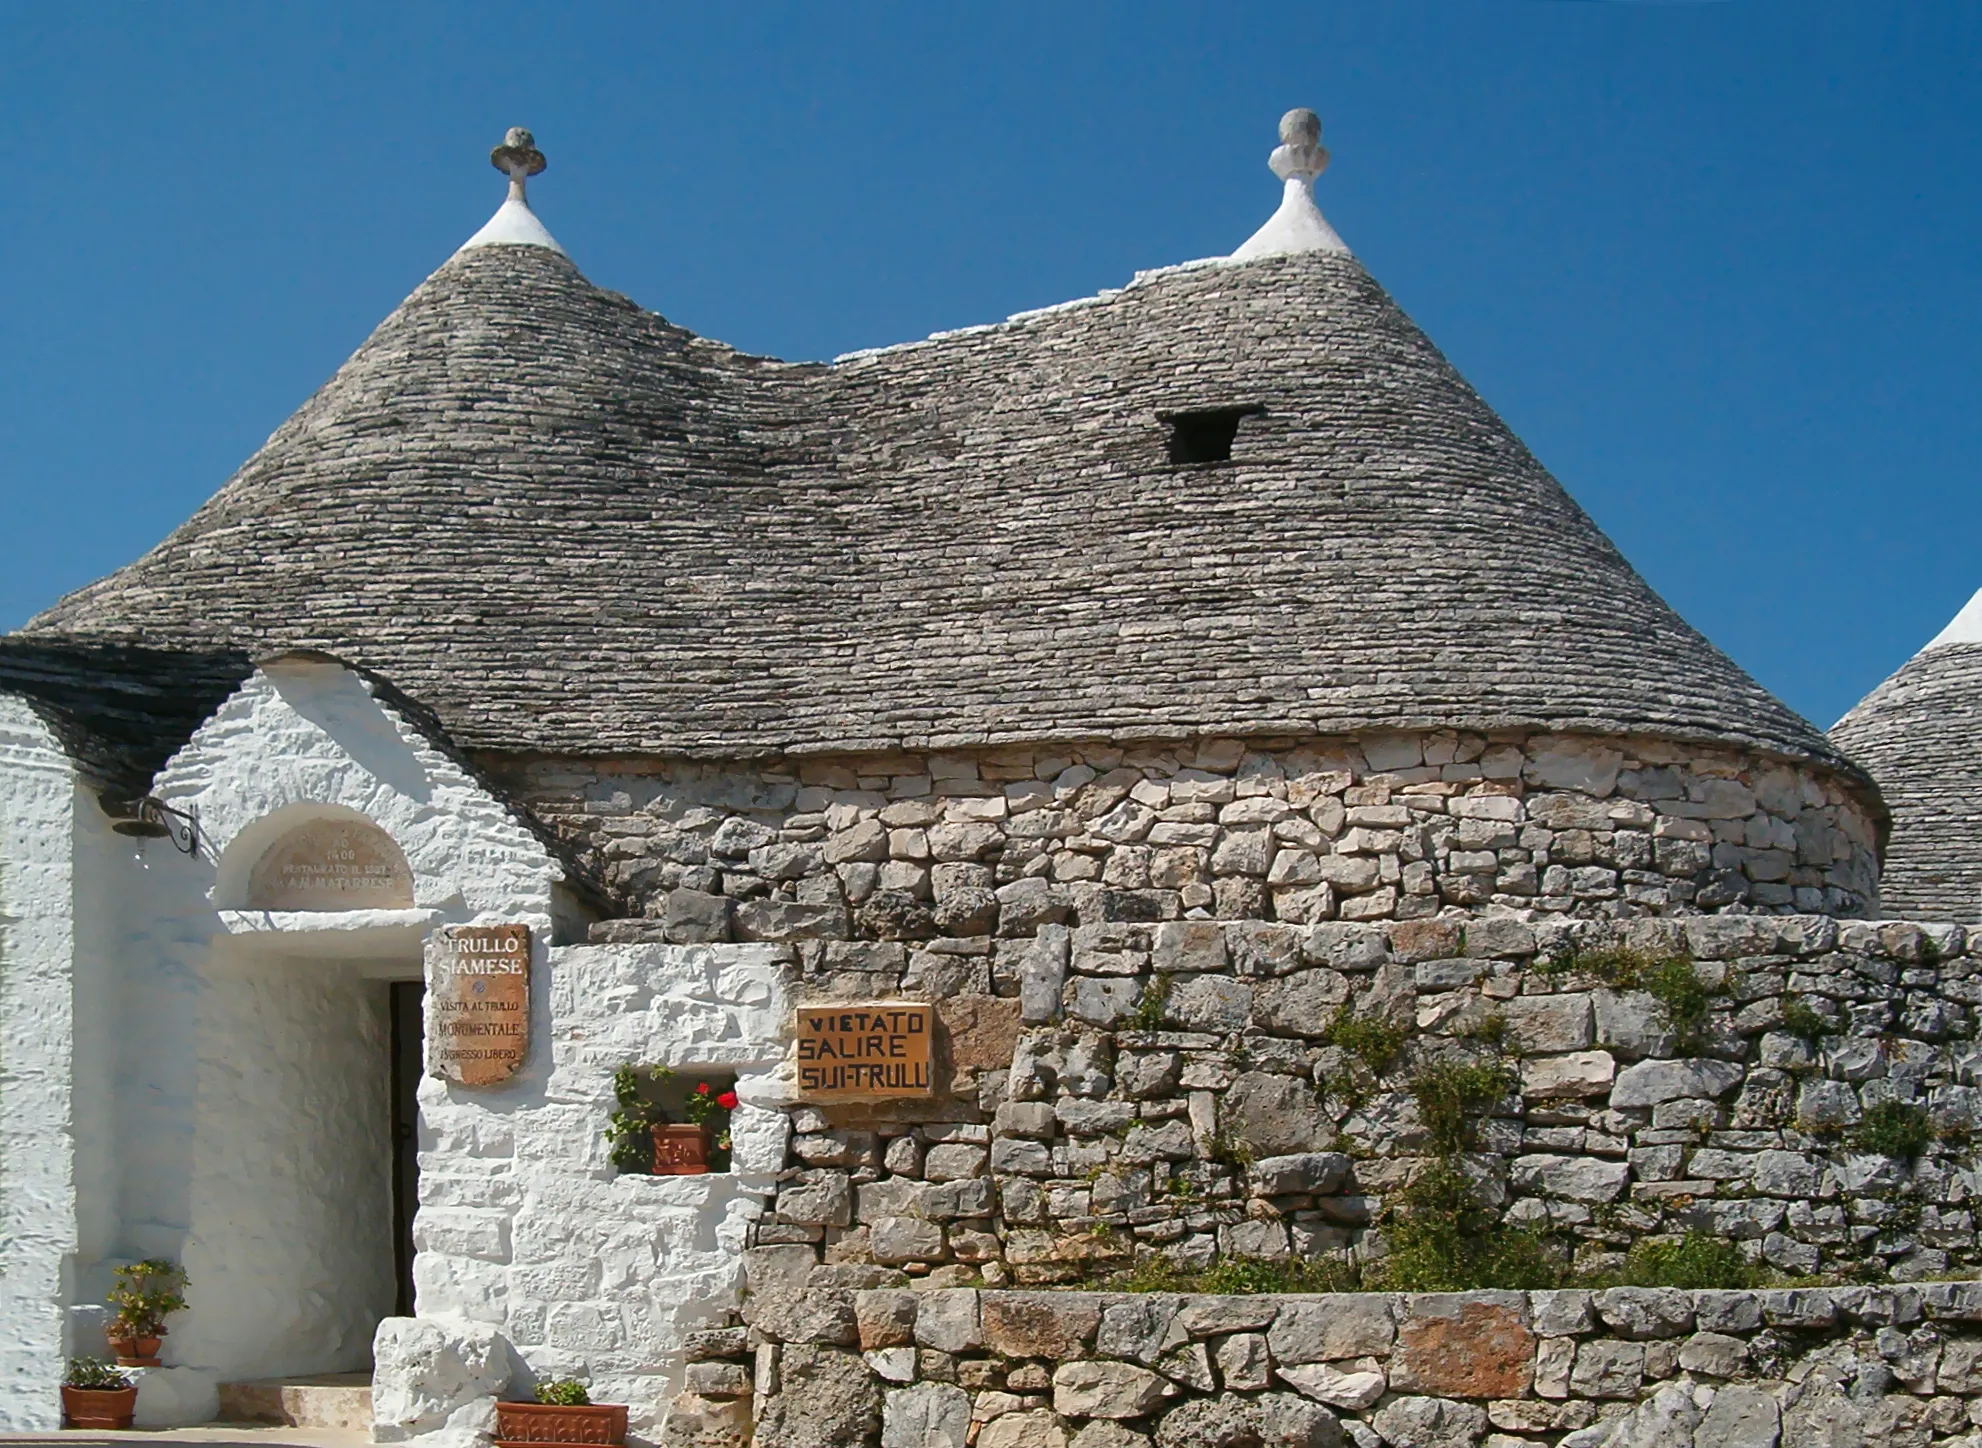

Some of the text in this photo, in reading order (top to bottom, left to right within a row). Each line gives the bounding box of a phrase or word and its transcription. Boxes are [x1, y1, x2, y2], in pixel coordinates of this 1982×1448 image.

[447, 937, 519, 953] TRULLO
[438, 958, 523, 975] SIAMESE
[440, 1001, 519, 1013] VISITA AL TRULLO
[438, 1022, 520, 1037] MONUMENTALE
[809, 1011, 924, 1034] VIETATO
[440, 1048, 517, 1060] INGRESSO LIBERO
[798, 1034, 908, 1061] SALIRE
